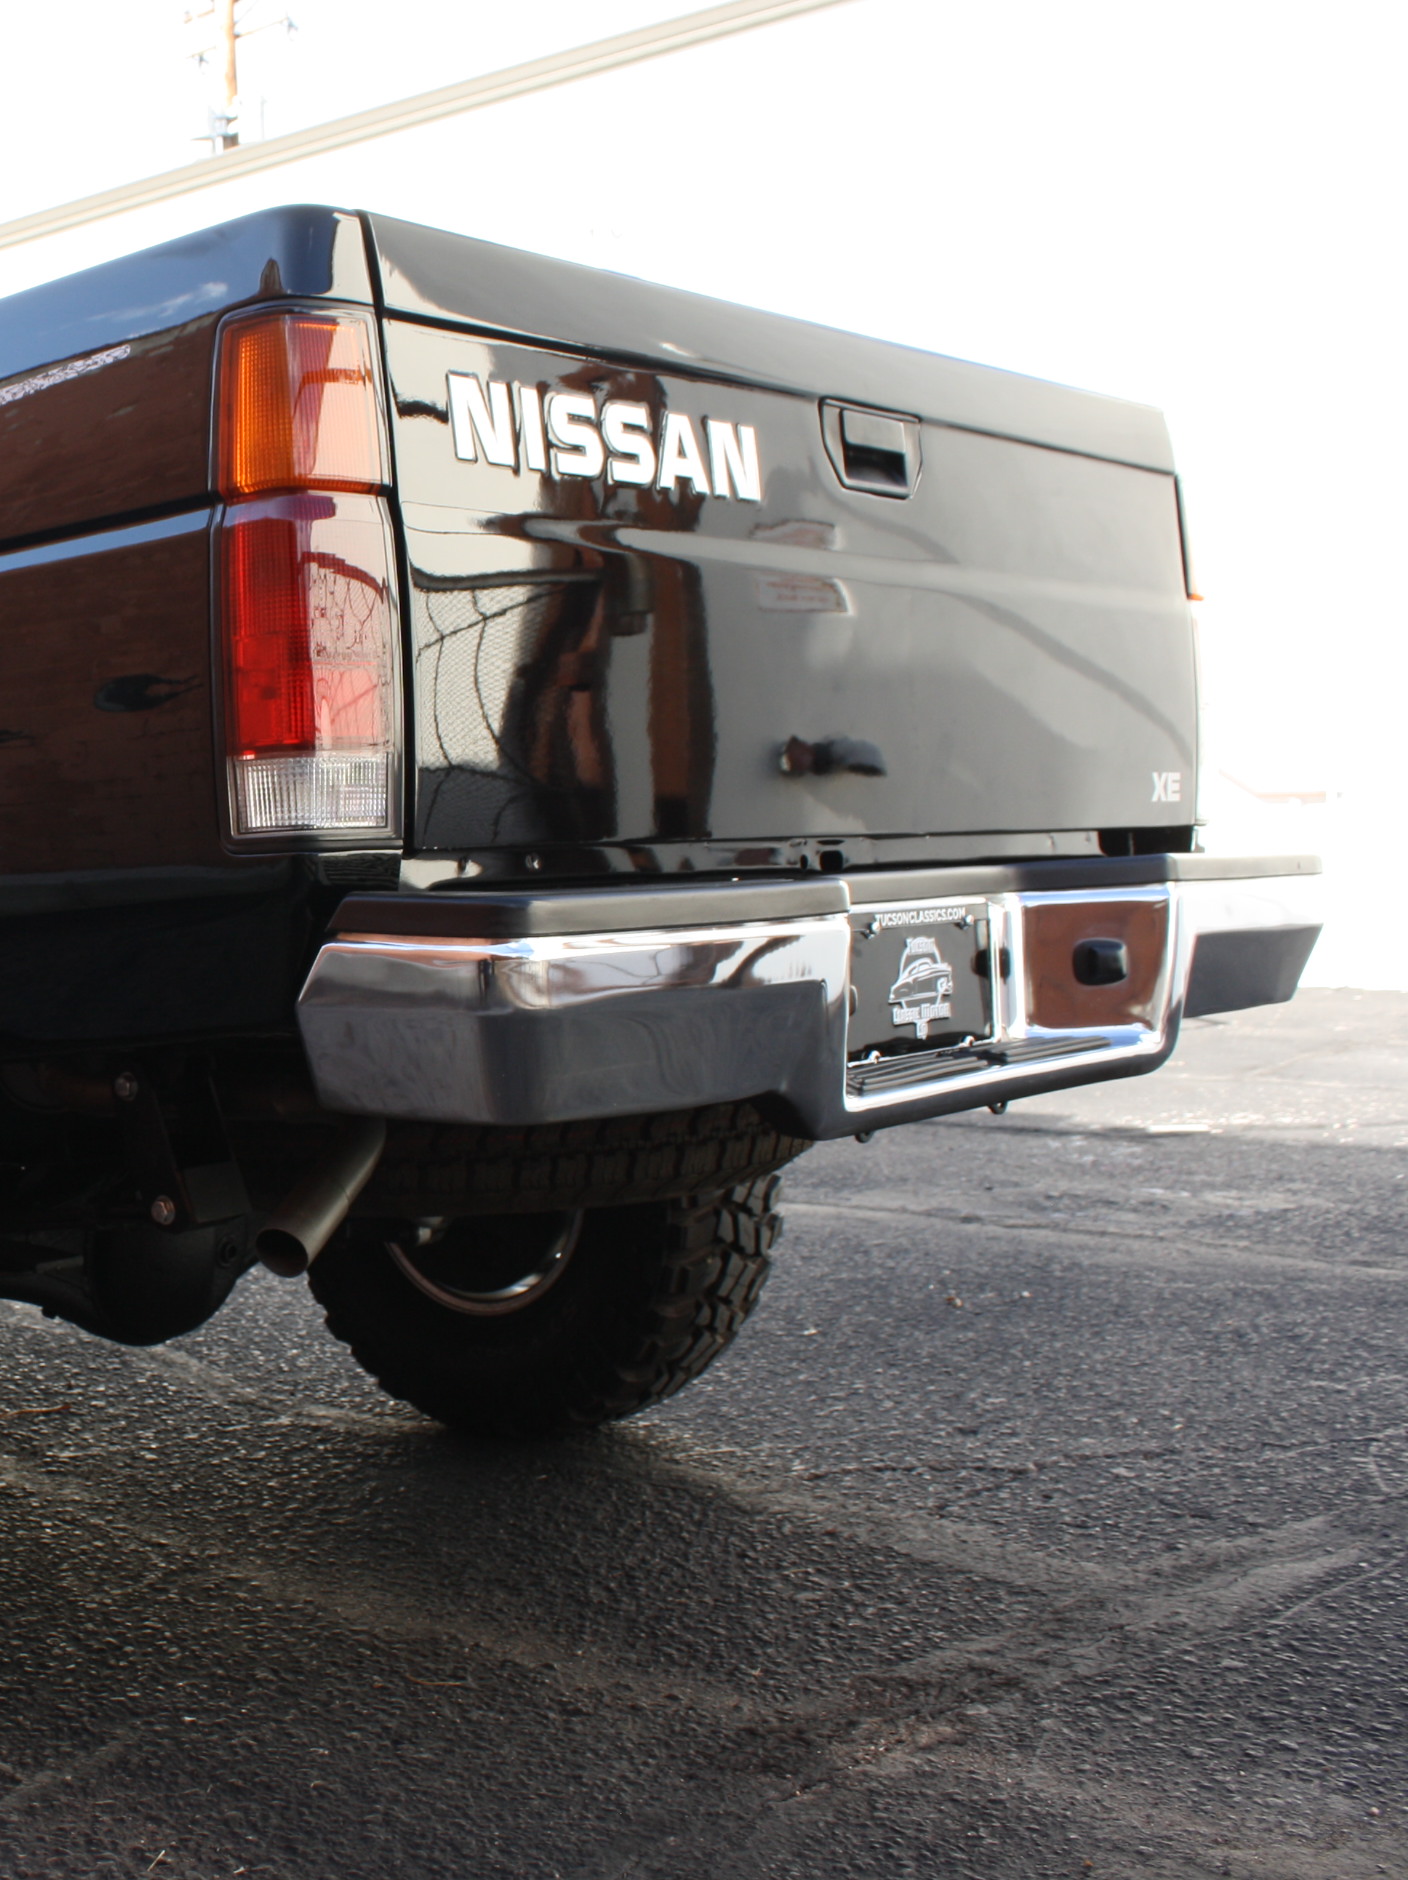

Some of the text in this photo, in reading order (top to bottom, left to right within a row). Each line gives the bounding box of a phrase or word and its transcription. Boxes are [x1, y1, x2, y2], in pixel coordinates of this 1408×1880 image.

[445, 370, 761, 501] NISSAN
[1151, 771, 1181, 802] XE
[875, 906, 966, 927] TUCSONCLASSICS.COM
